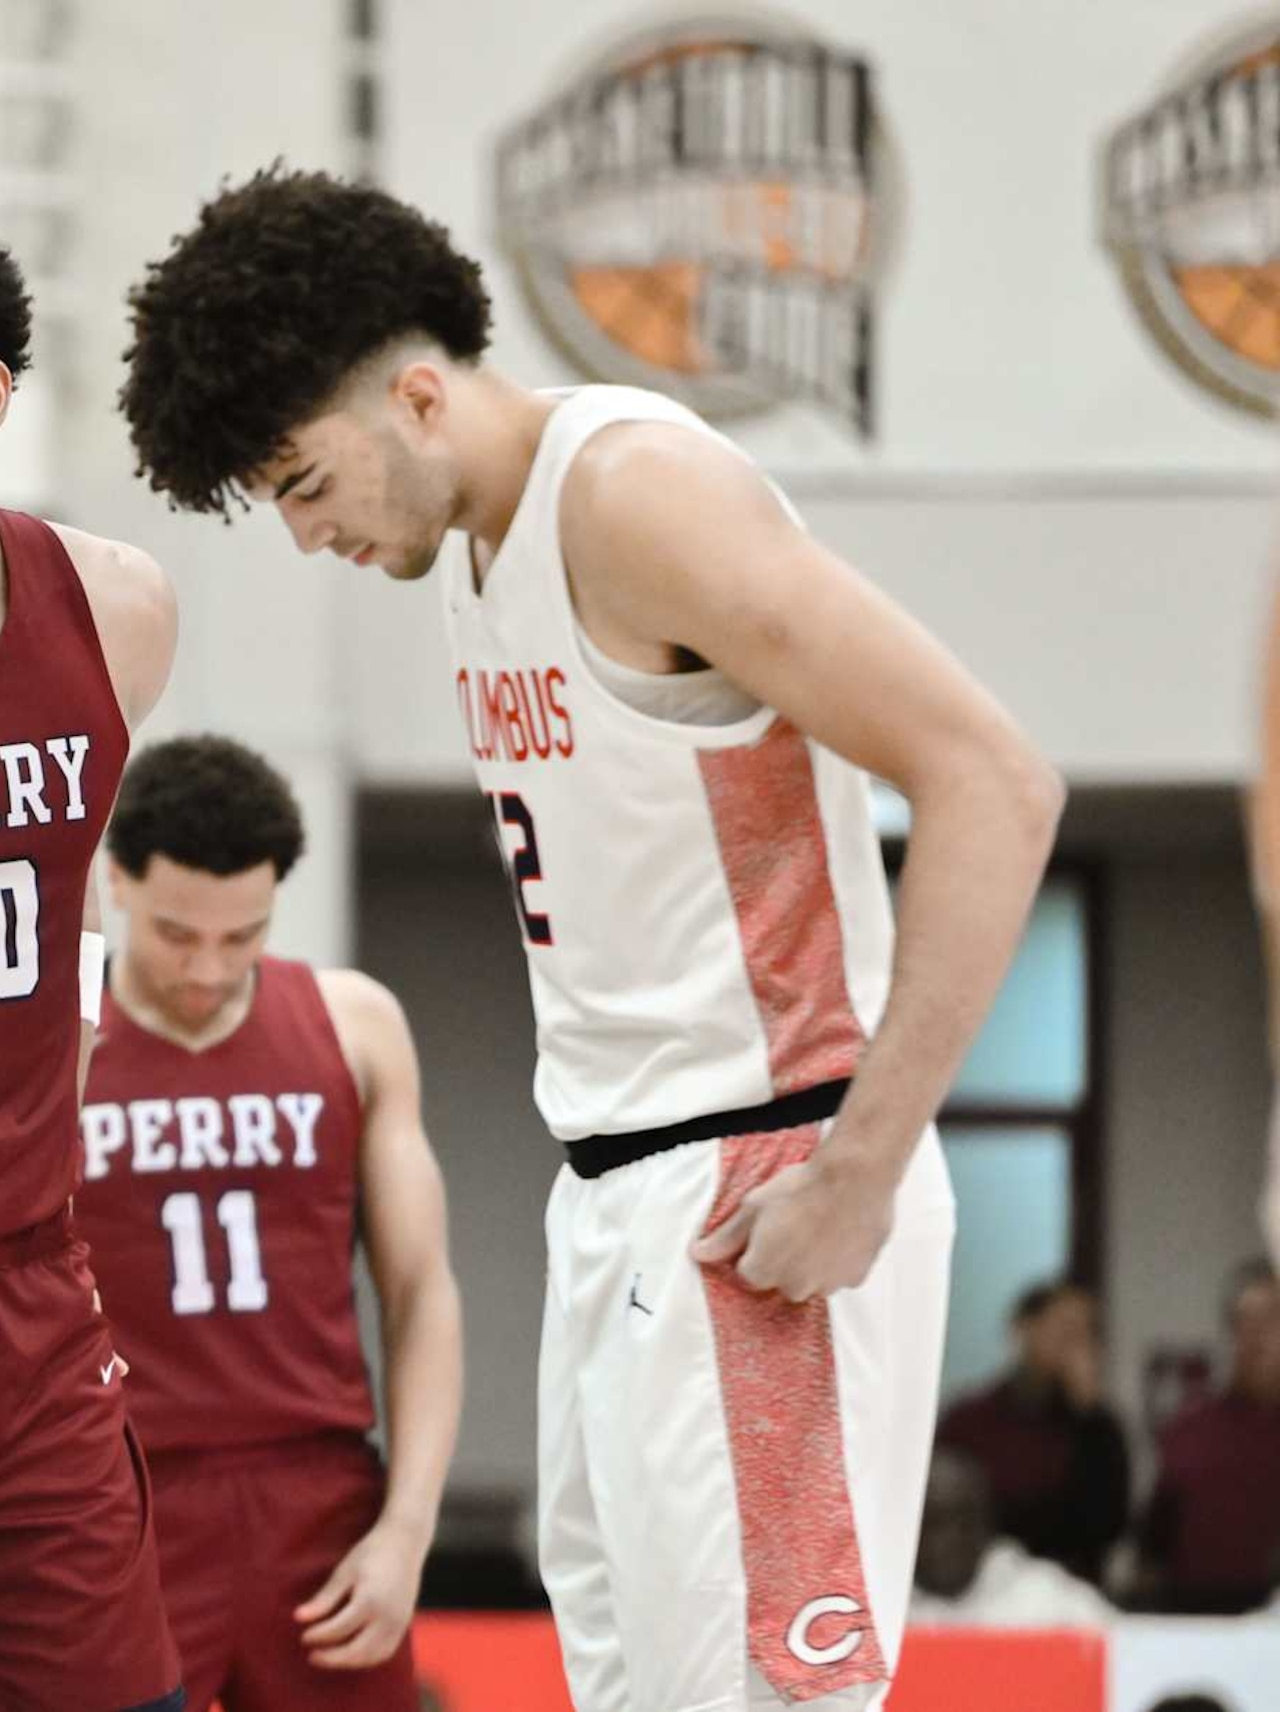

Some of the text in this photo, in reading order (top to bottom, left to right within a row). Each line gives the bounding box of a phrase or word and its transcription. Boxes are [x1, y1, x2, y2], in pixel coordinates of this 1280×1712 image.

[80, 1092, 324, 1181] PERRY
[161, 1189, 270, 1316] 11
[784, 1592, 865, 1666] C
